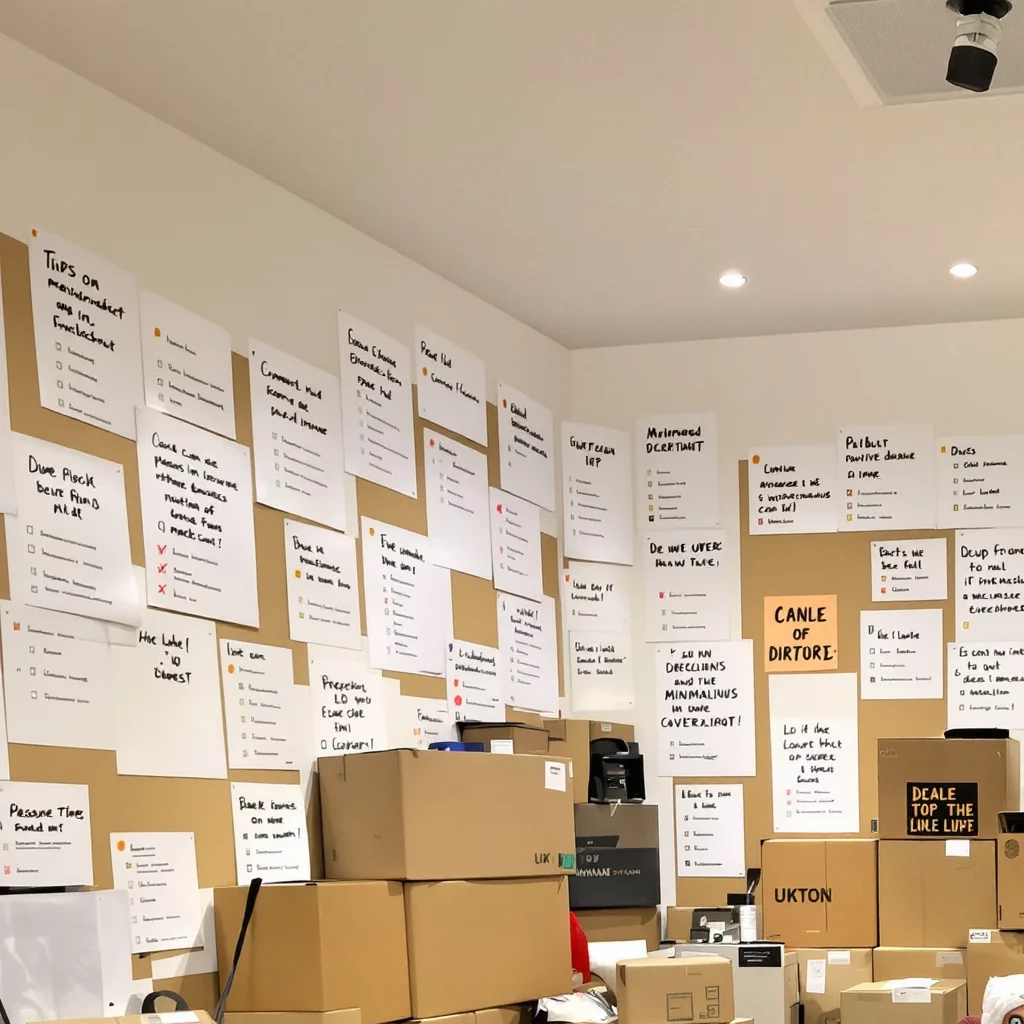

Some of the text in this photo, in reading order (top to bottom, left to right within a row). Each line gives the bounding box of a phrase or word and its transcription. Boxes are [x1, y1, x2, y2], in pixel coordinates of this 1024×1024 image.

[775, 606, 827, 623] CANLE
[793, 628, 810, 640] OF
[947, 803, 974, 817] THE
[774, 887, 832, 904] UKTON
